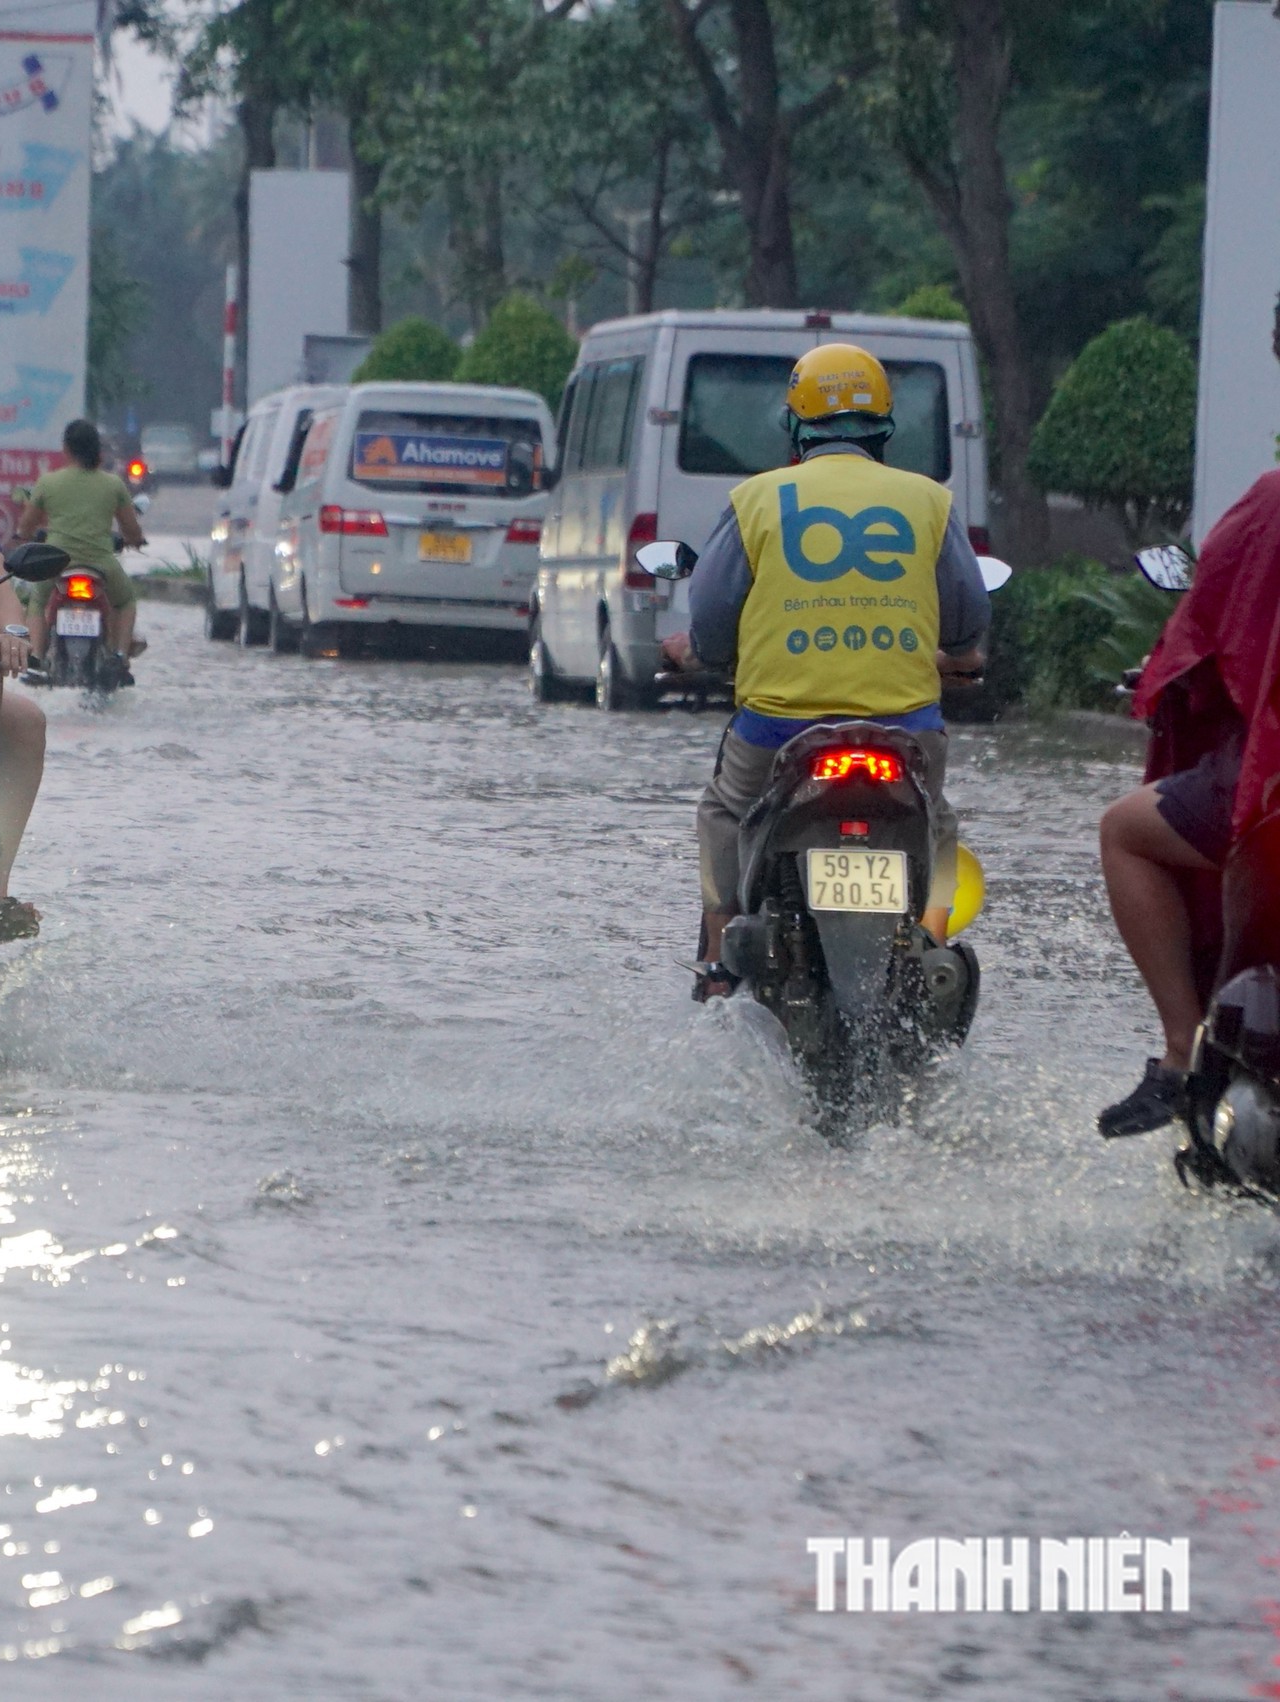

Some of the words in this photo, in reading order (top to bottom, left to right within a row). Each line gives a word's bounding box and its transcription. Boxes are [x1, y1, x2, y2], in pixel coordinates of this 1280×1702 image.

[401, 441, 501, 467] Ahamove
[778, 483, 916, 583] be
[784, 598, 809, 612] Bên
[812, 595, 846, 608] nhau
[849, 594, 877, 610] trọn
[824, 854, 891, 880] 59-Y2
[815, 881, 901, 908] 780.54
